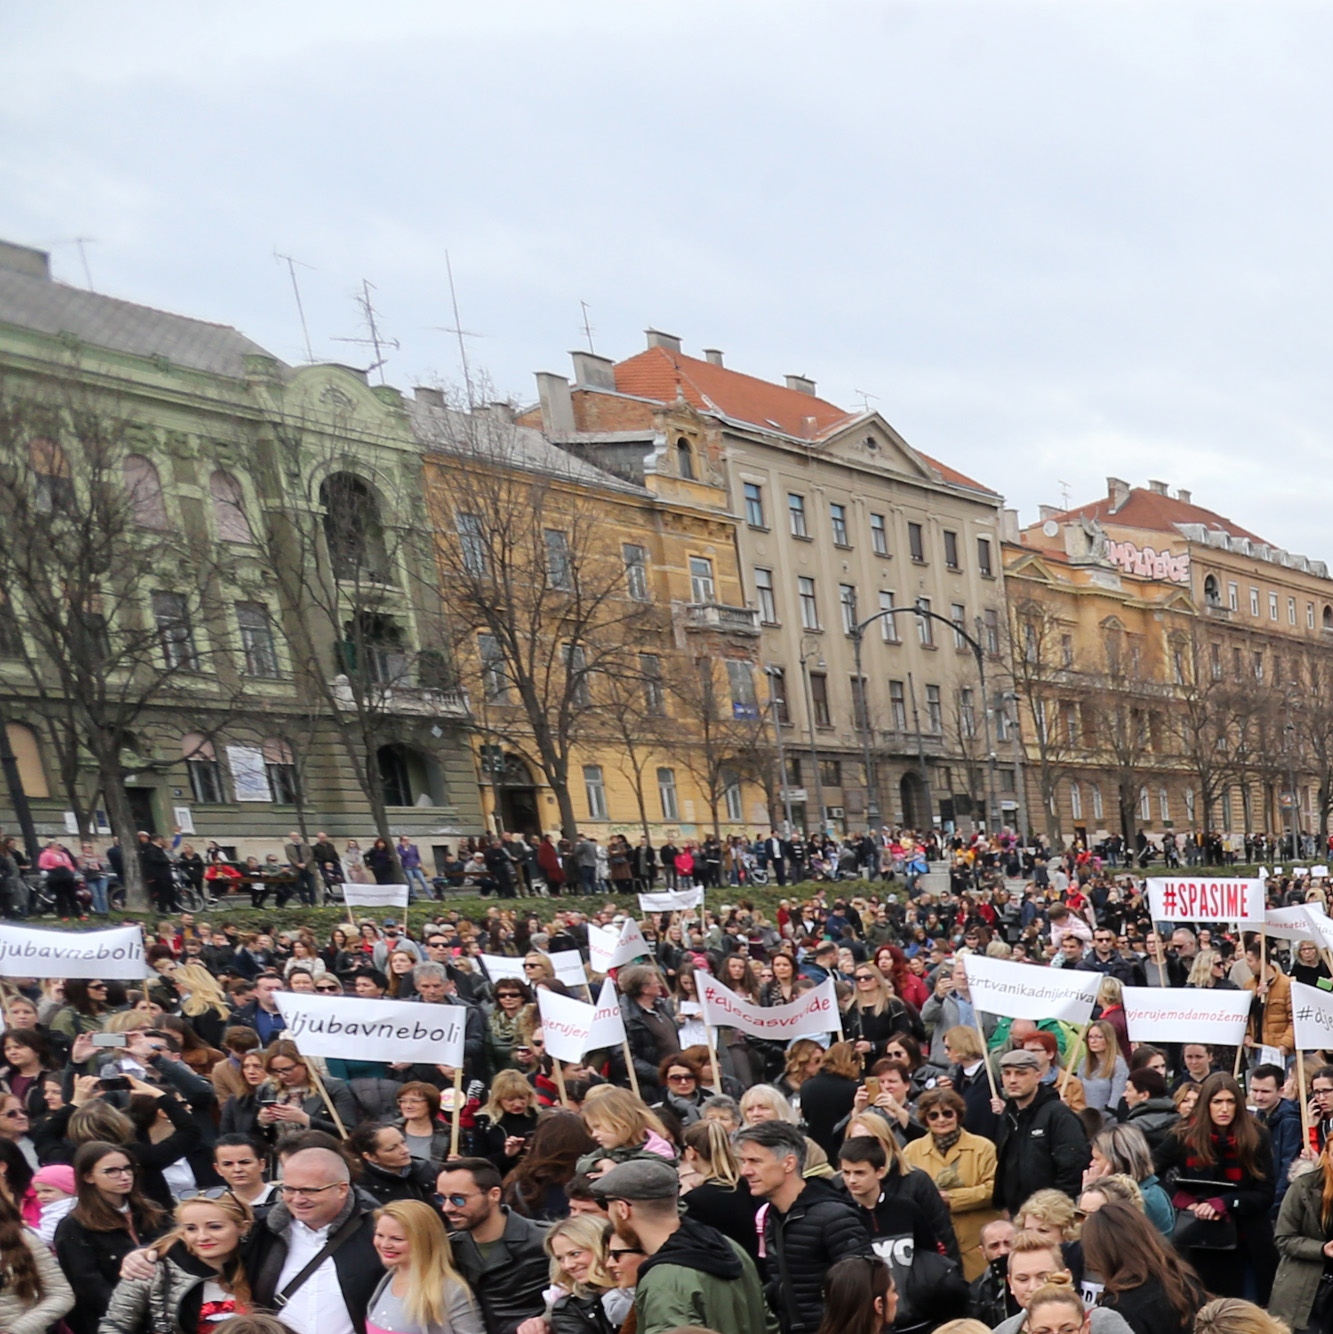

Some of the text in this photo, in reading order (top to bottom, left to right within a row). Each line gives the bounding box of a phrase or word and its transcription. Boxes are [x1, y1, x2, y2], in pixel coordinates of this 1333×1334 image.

[1163, 882, 1248, 917] #SPASIME
[705, 986, 831, 1028] #djecasvevide
[284, 1010, 461, 1044] ljubavneboli
